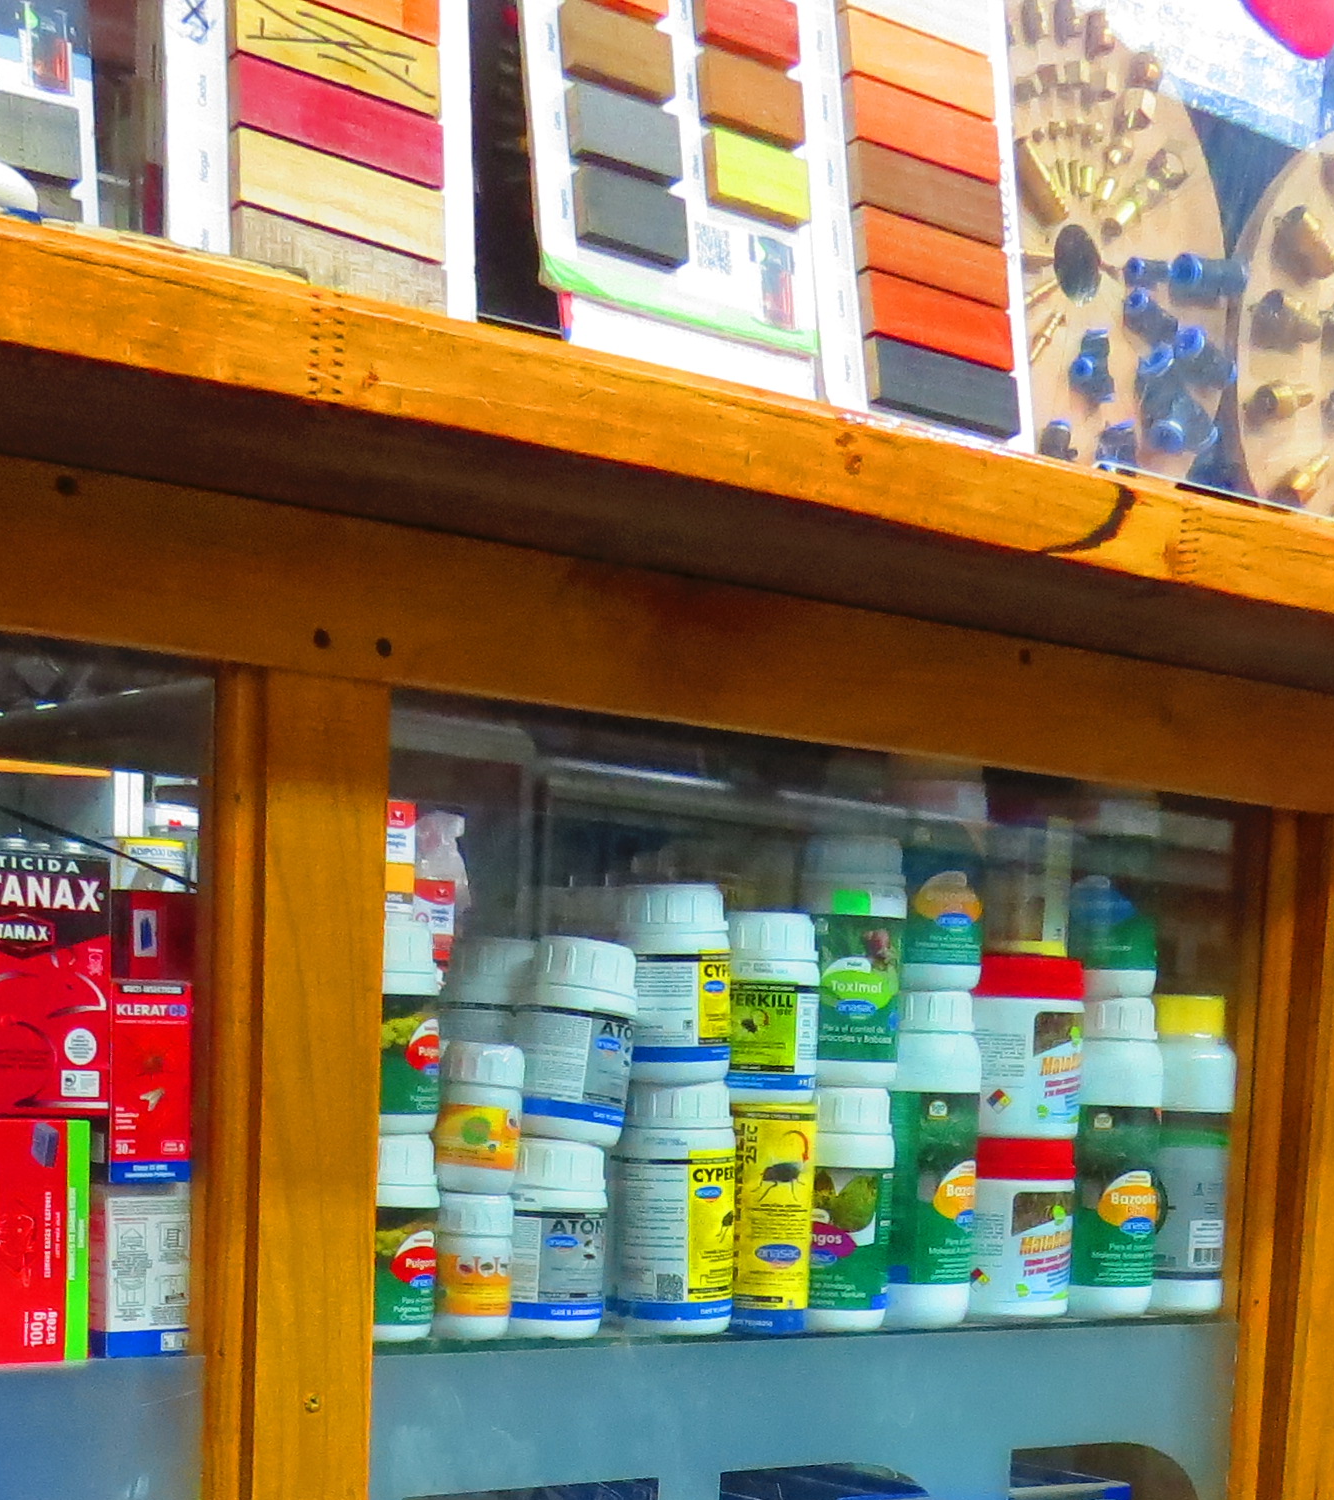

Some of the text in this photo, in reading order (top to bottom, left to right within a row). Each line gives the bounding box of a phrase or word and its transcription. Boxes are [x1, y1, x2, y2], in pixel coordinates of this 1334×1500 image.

[830, 979, 883, 995] Toximol
[115, 1003, 168, 1016] KLERAT
[755, 1247, 801, 1261] anasac
[29, 1327, 44, 1348] 100
